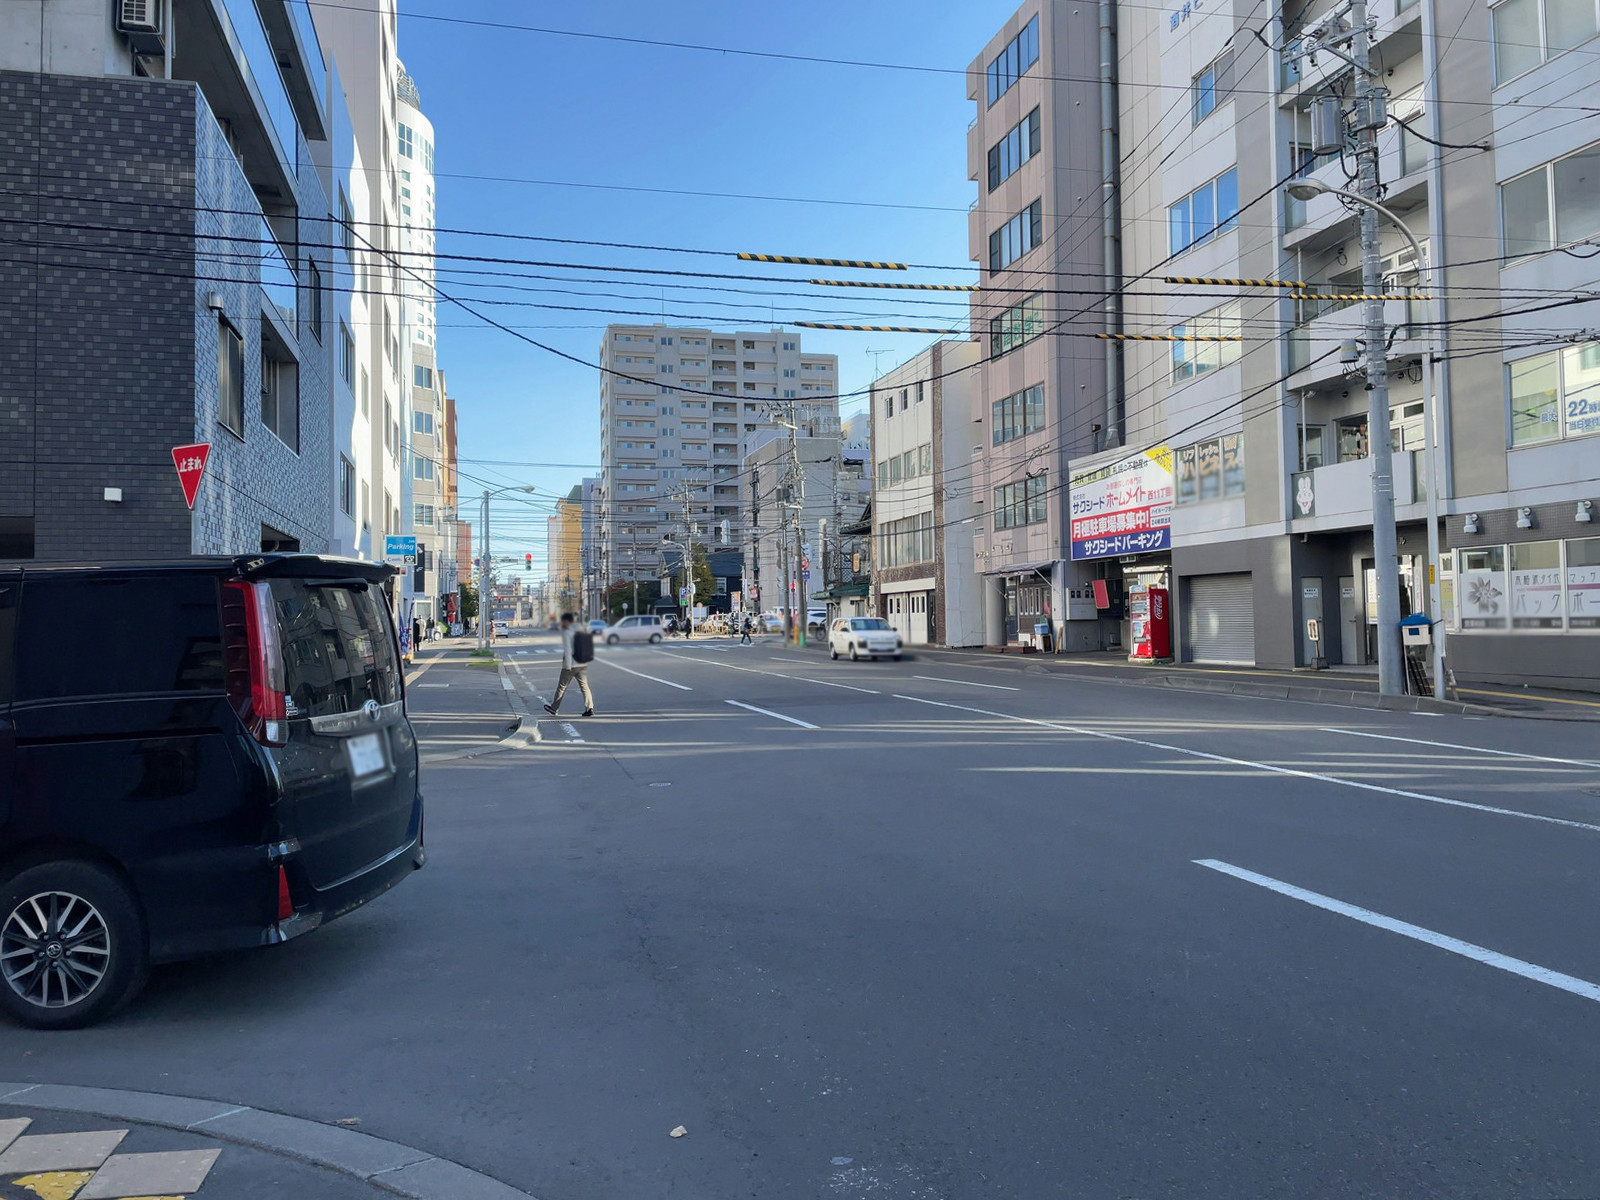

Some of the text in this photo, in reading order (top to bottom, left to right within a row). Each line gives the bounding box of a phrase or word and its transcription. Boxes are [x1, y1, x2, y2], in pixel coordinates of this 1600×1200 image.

[180, 456, 203, 472] 止まれ
[1073, 496, 1105, 515] サクシード
[1106, 486, 1146, 508] ホームメイト
[387, 543, 415, 551] Parking
[1085, 530, 1164, 556] サクシードパーキング
